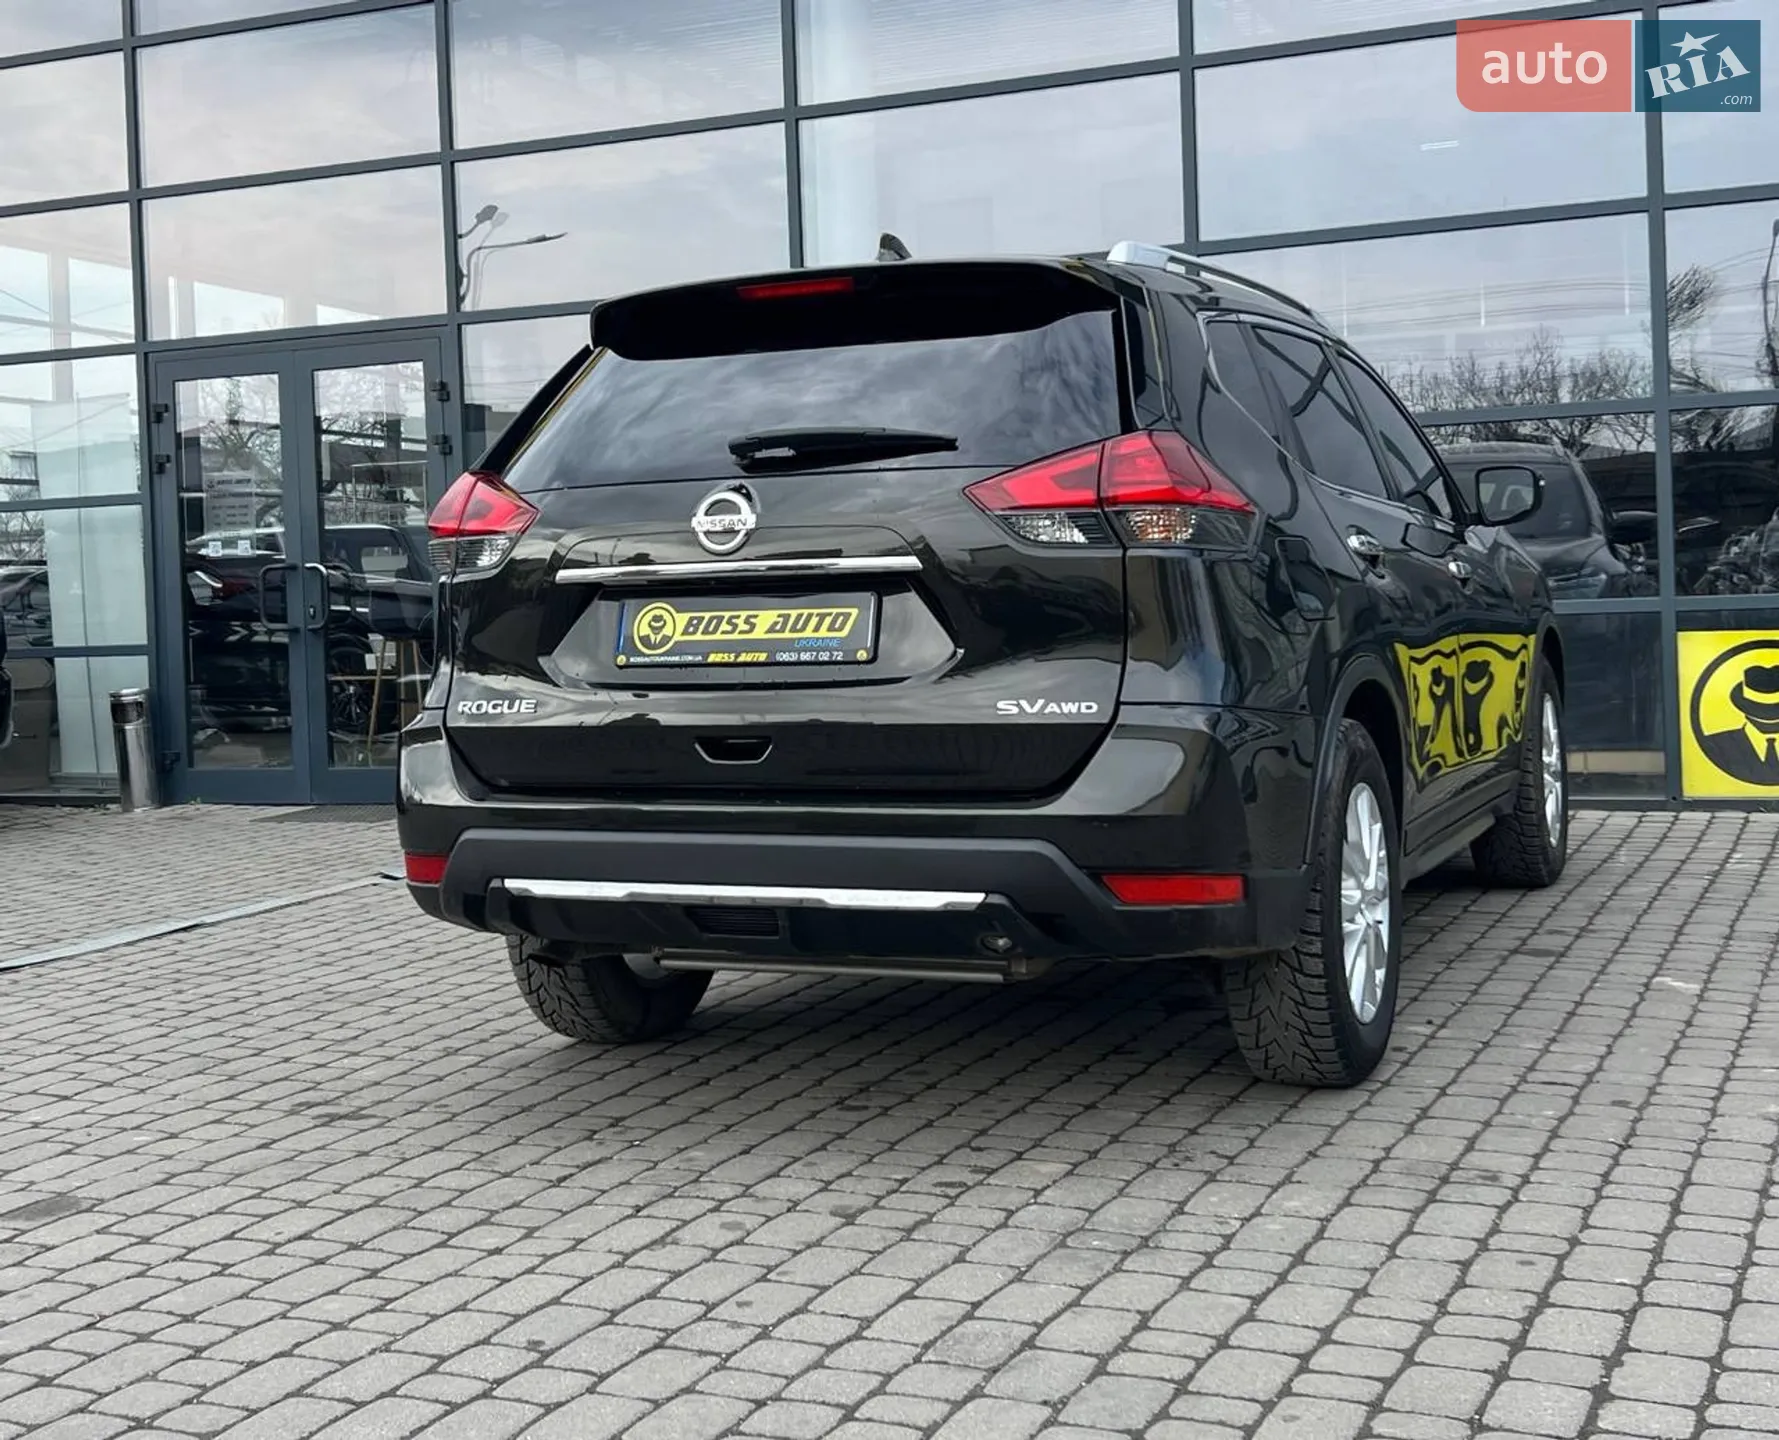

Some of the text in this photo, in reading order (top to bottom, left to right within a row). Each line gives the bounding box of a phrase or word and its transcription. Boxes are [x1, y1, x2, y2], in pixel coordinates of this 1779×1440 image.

[697, 517, 748, 530] NISSAN
[680, 611, 852, 637] BOSS AUTO
[794, 638, 842, 648] UKRAINE
[706, 652, 769, 662] BOSS AUTO
[776, 651, 843, 661] (063) 667 02 72
[457, 699, 537, 715] ROGUE
